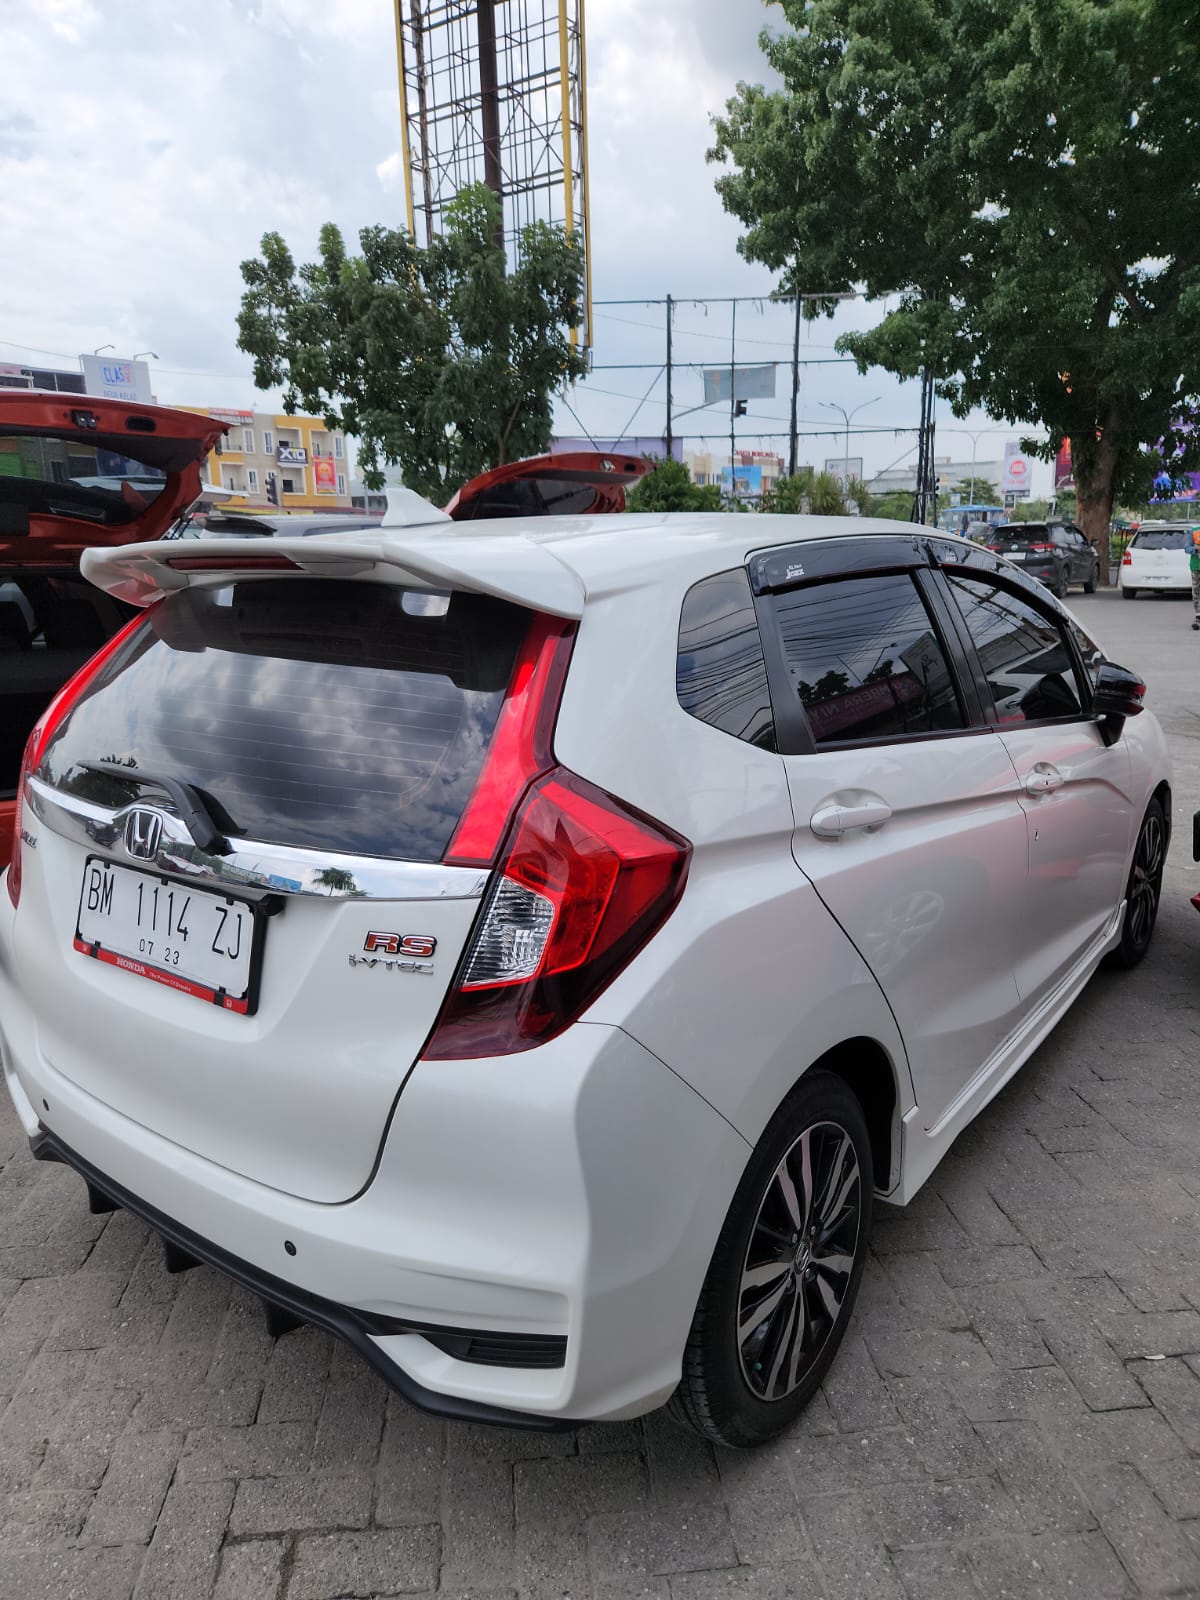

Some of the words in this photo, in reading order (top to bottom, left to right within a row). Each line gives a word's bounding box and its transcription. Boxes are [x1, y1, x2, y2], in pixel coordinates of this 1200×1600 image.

[87, 868, 115, 916] BM
[137, 882, 192, 942] 1114
[211, 905, 242, 960] ZJ
[139, 938, 154, 956] 07
[164, 947, 180, 965] 23
[363, 930, 438, 957] RS
[116, 957, 146, 976] HONDA
